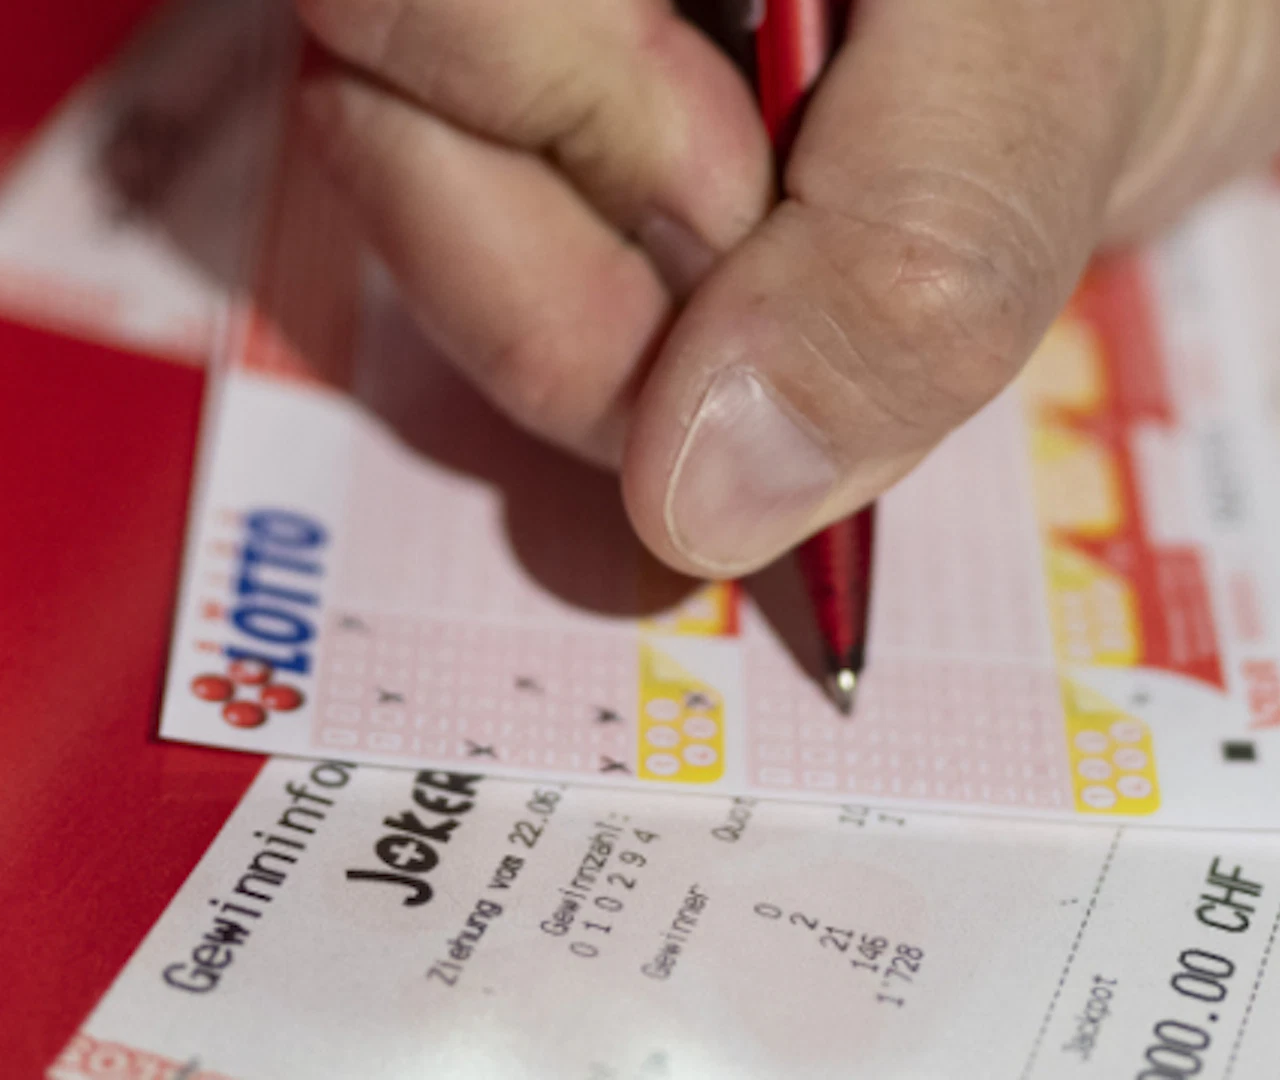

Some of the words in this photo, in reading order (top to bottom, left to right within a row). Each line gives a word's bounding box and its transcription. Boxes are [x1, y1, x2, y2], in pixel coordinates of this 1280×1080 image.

[225, 509, 328, 676] LOTTO
[346, 770, 486, 908] JOKER
[640, 883, 710, 981] Gewinner
[818, 925, 855, 953] 21
[1194, 854, 1264, 934] CHF
[426, 899, 504, 987] Ziehung
[1061, 973, 1119, 1063] Jackpot
